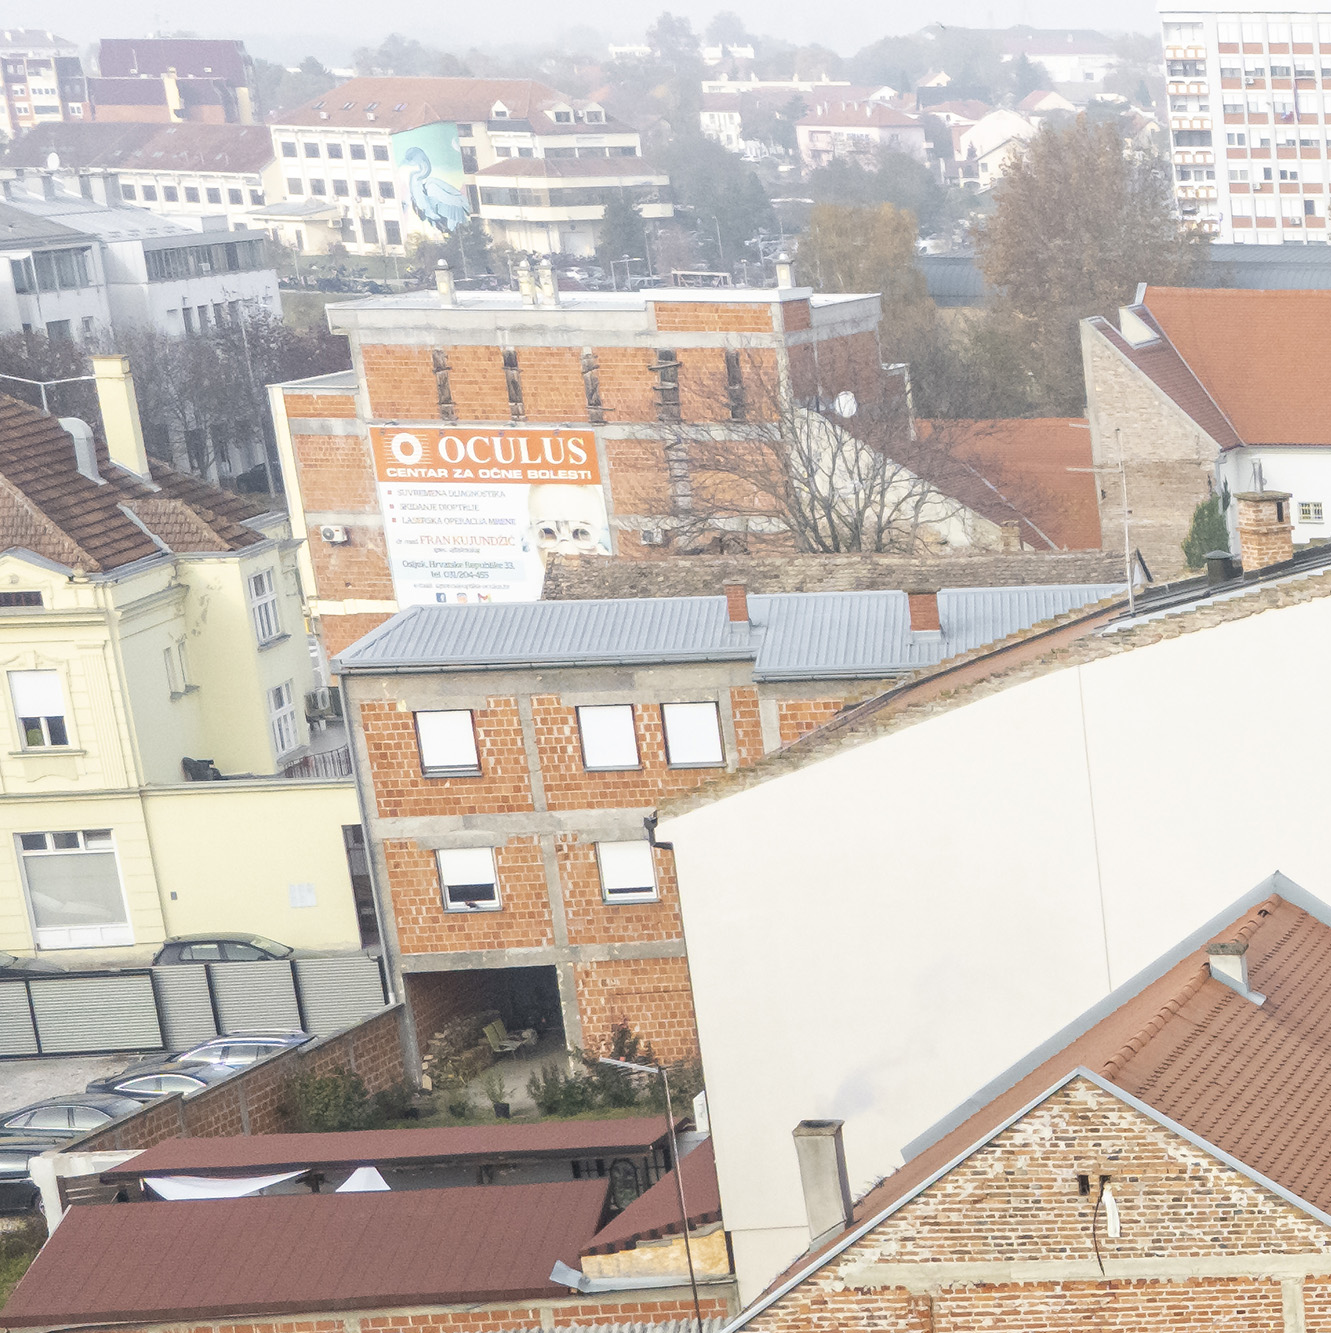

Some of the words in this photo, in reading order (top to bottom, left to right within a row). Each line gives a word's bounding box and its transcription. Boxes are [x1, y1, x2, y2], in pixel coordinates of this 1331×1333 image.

[438, 436, 588, 465] OCULUS
[386, 467, 448, 478] CENTAR
[453, 468, 474, 479] ZA
[478, 467, 523, 480] OČNE
[527, 470, 592, 480] BOLESTI
[420, 535, 451, 545] FRAN
